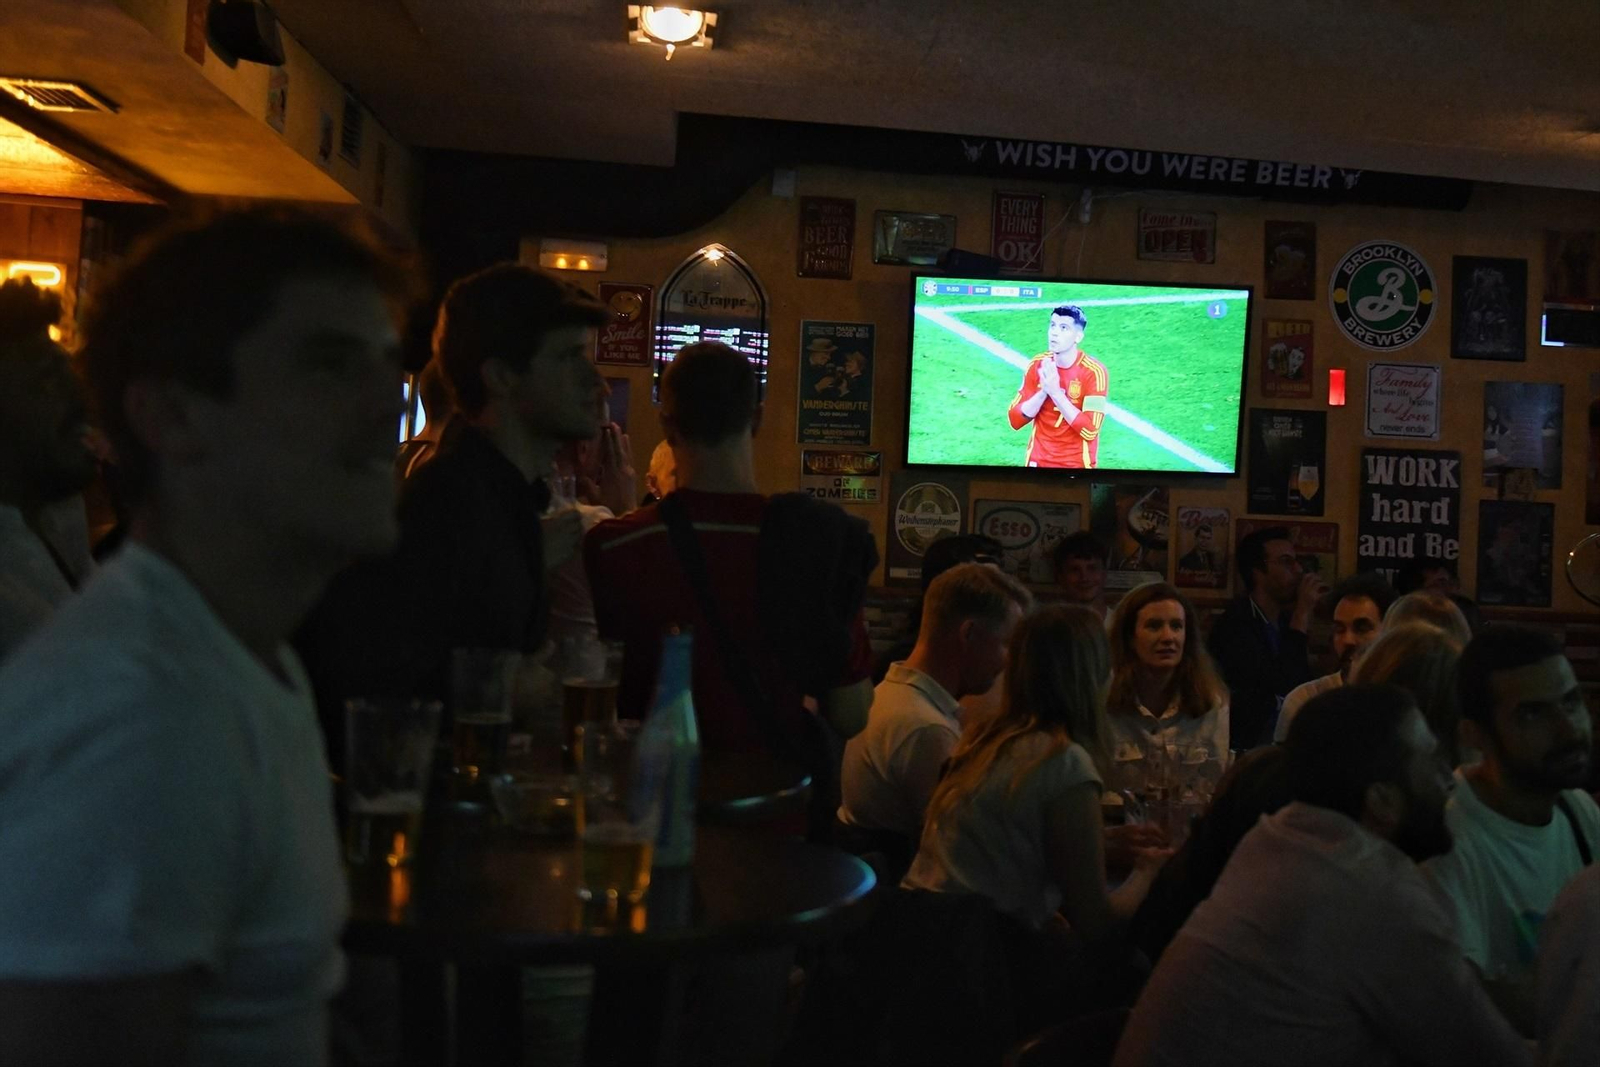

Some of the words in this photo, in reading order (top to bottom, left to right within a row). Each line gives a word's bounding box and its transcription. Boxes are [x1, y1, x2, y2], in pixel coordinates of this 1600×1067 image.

[996, 140, 1077, 170] WISH
[1087, 148, 1152, 175] YOU
[1161, 153, 1248, 182] WERE
[1255, 160, 1333, 189] BEER
[1000, 198, 1039, 216] EVERY
[804, 226, 848, 244] BEER
[1000, 216, 1037, 234] THING
[999, 240, 1038, 263] OK
[1342, 246, 1424, 276] BROOKLYN
[681, 290, 698, 307] La
[699, 291, 747, 309] Trappe
[1214, 304, 1221, 315] 1
[601, 321, 645, 344] Smile
[1344, 316, 1422, 345] BREWERY
[604, 351, 625, 359] LIKE
[1375, 367, 1433, 400] Family
[1053, 406, 1064, 428] 7
[1364, 454, 1459, 488] WORK
[806, 488, 877, 499] ZOMBIES
[1371, 493, 1450, 525] hard
[899, 515, 958, 527] Weihenstephaner
[1359, 533, 1415, 559] and
[1424, 532, 1459, 560] Be
